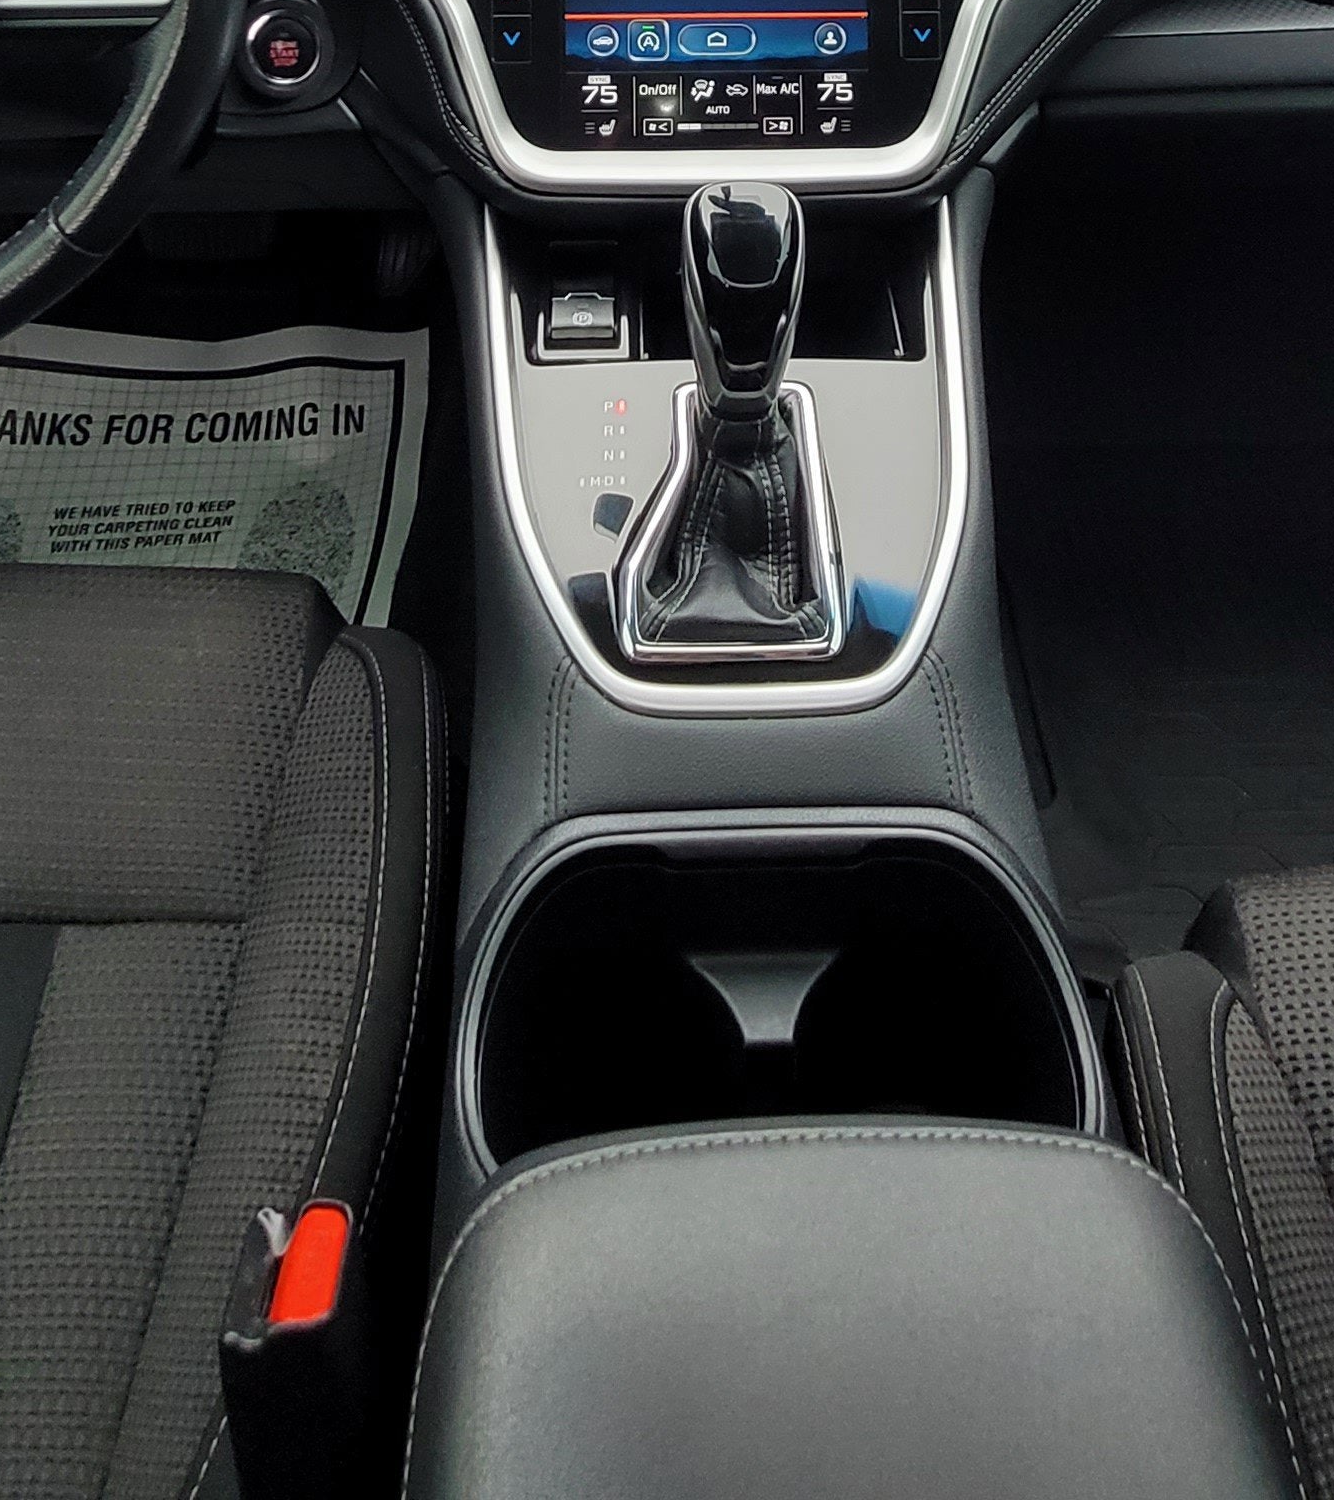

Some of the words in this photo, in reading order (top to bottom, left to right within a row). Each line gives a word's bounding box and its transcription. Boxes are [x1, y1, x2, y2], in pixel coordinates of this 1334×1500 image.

[581, 85, 618, 105] 75
[638, 84, 677, 96] On/Off
[756, 83, 777, 95] Max
[780, 83, 799, 95] A/C
[817, 83, 853, 102] 75
[705, 105, 730, 115] AUTO
[604, 401, 614, 413] P
[102, 413, 174, 445] FOR
[185, 402, 319, 444] COMING
[332, 403, 366, 436] IN
[604, 425, 614, 436] R
[604, 449, 614, 461] N
[53, 507, 79, 520] WE
[81, 504, 120, 519] HAVE
[126, 502, 170, 517] TRIED
[175, 501, 194, 514] TO
[198, 499, 236, 514] KEEP
[48, 522, 89, 537] YOUR
[94, 518, 180, 535] CARPETING
[184, 515, 234, 530] CLEAN
[50, 539, 91, 555] WITH
[96, 536, 131, 551] THIS
[134, 533, 184, 549] PAPER
[188, 531, 223, 545] MAT
